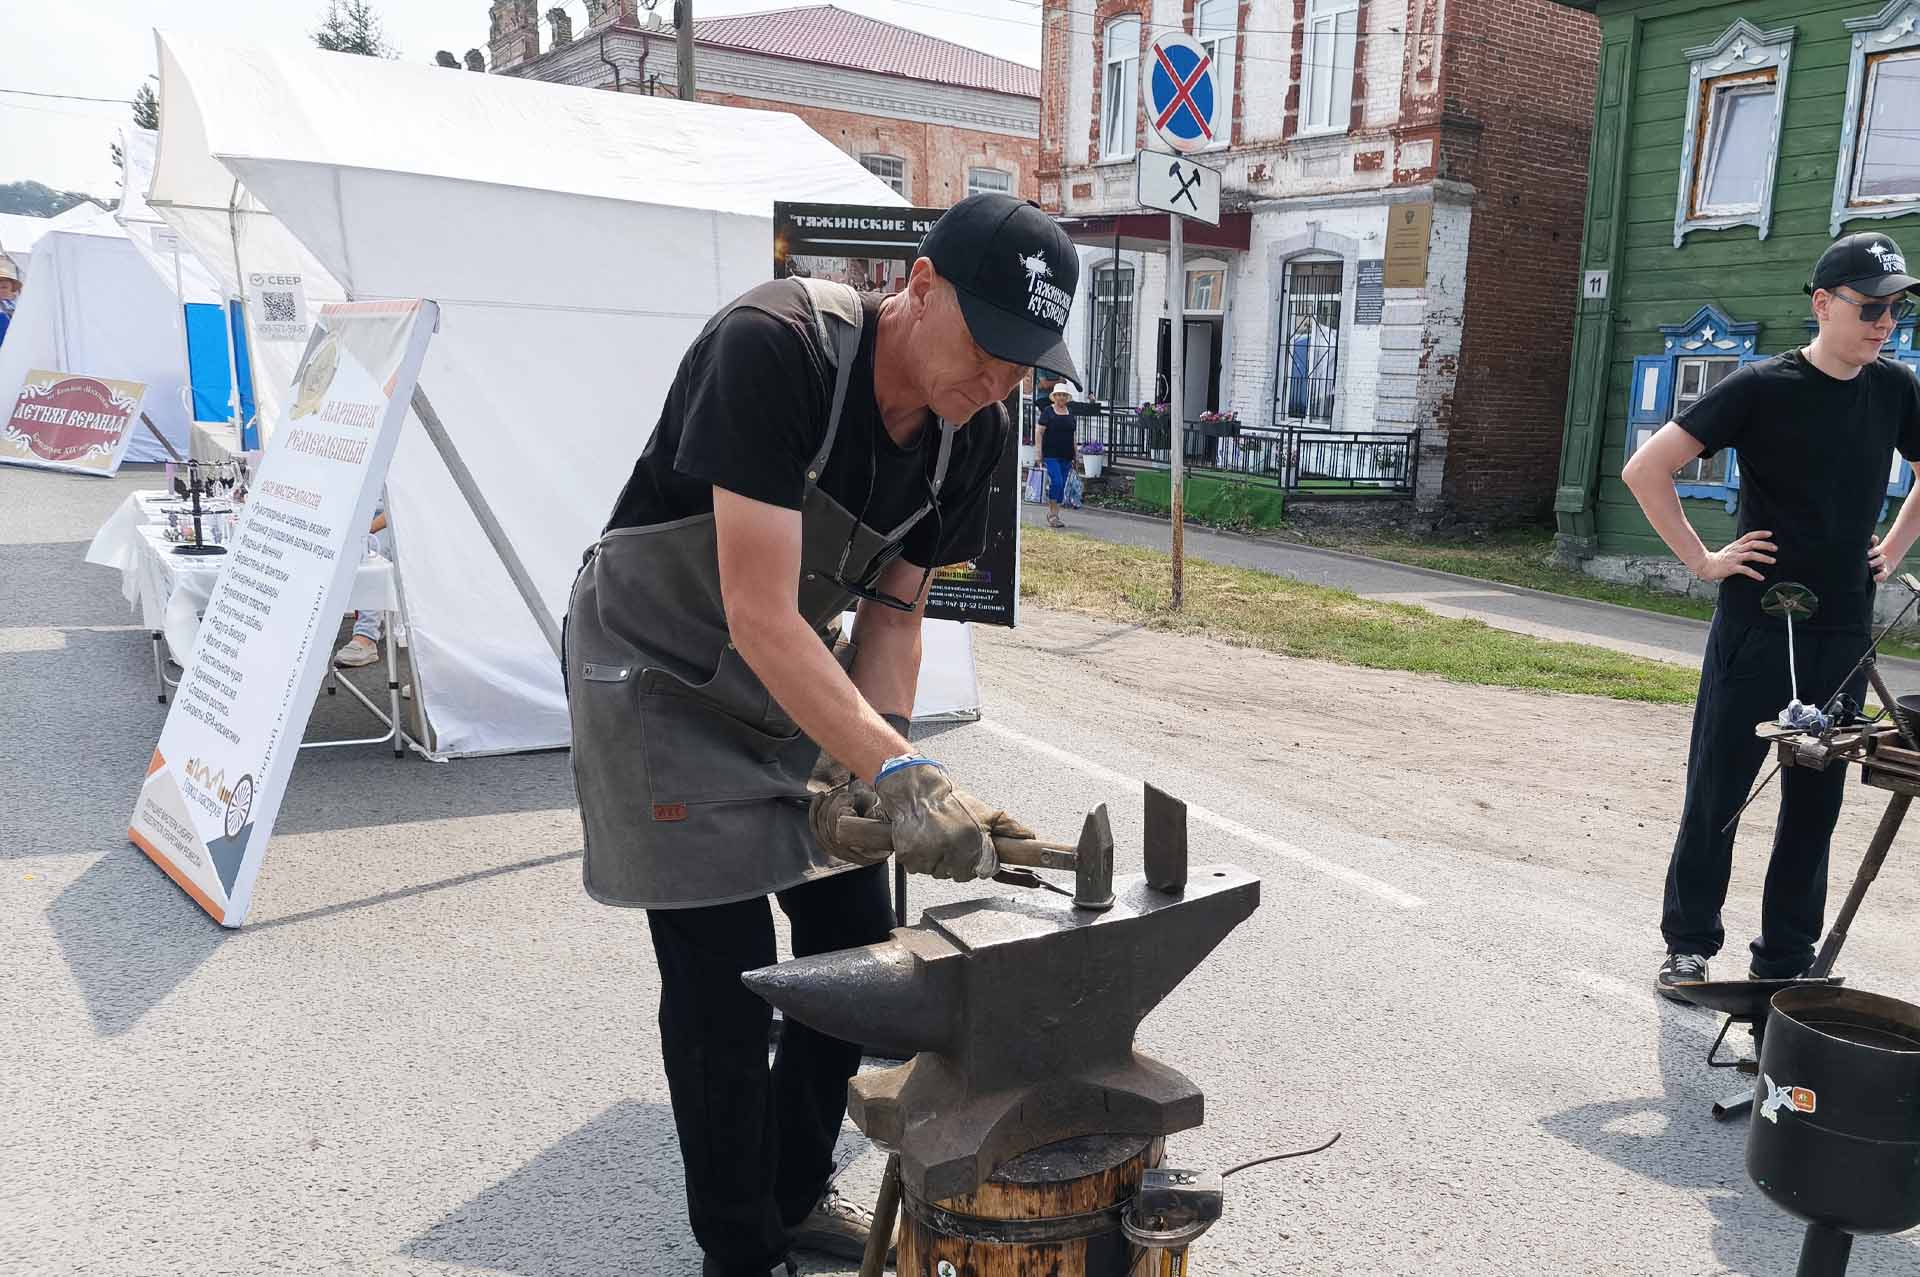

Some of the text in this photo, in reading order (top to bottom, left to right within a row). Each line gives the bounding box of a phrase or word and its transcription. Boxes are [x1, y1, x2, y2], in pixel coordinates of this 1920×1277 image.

[268, 276, 301, 285] СБЕР
[1590, 276, 1601, 293] 11
[15, 402, 127, 433] ЛЕТНЯЯ ВЕРАНДА
